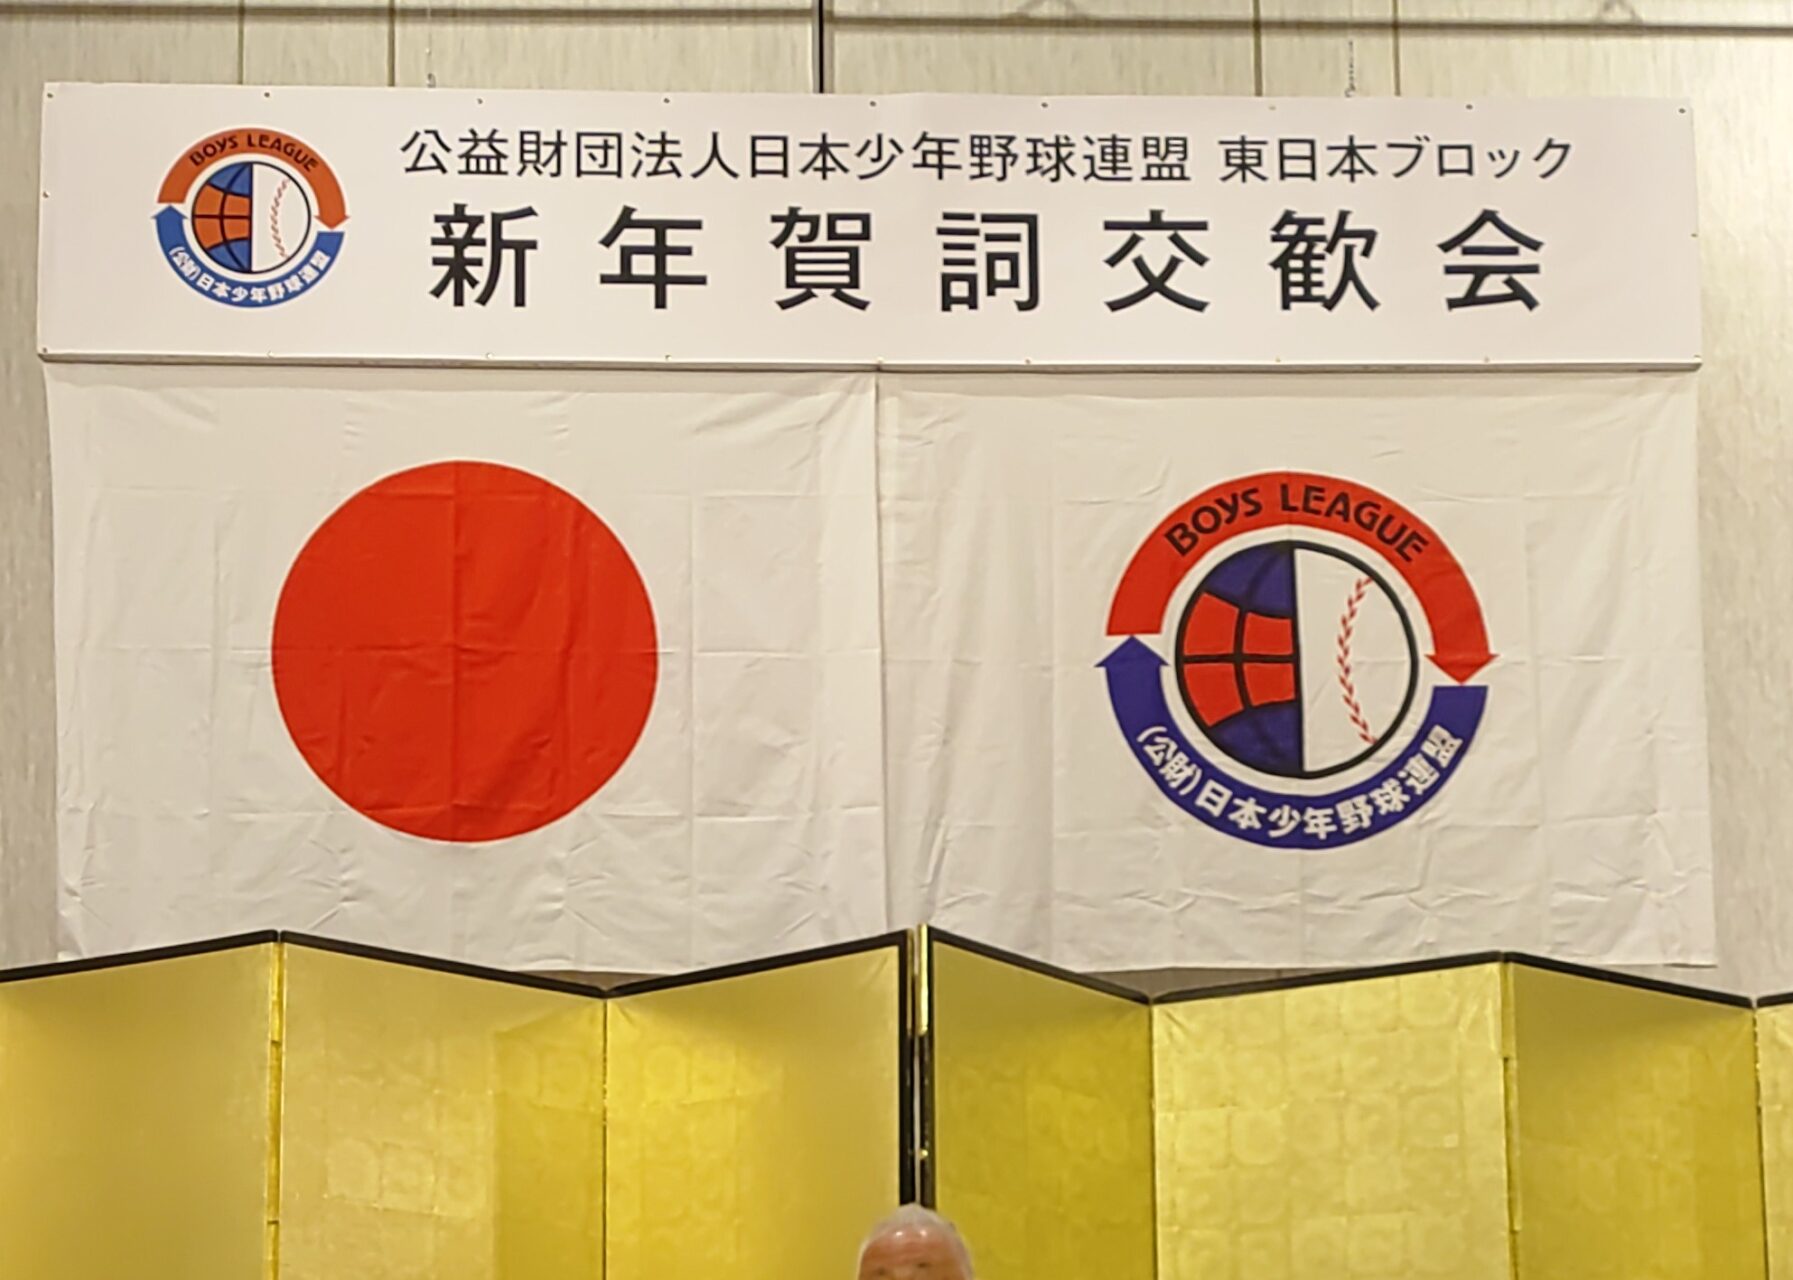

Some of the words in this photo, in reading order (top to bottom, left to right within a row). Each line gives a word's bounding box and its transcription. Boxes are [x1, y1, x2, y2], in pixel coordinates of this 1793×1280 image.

[189, 135, 238, 167] BOYS
[247, 133, 318, 172] LEAGUE
[400, 128, 1191, 183] 公益財団法人日本少年野球連盟
[1217, 134, 1573, 183] 東日本ブロック
[429, 203, 1545, 312] 新年賀詞交歓会
[1164, 487, 1263, 556] BOYS
[1279, 483, 1429, 563] LEAGUE
[1137, 724, 1463, 839] (公財)日本少年野球連盟
